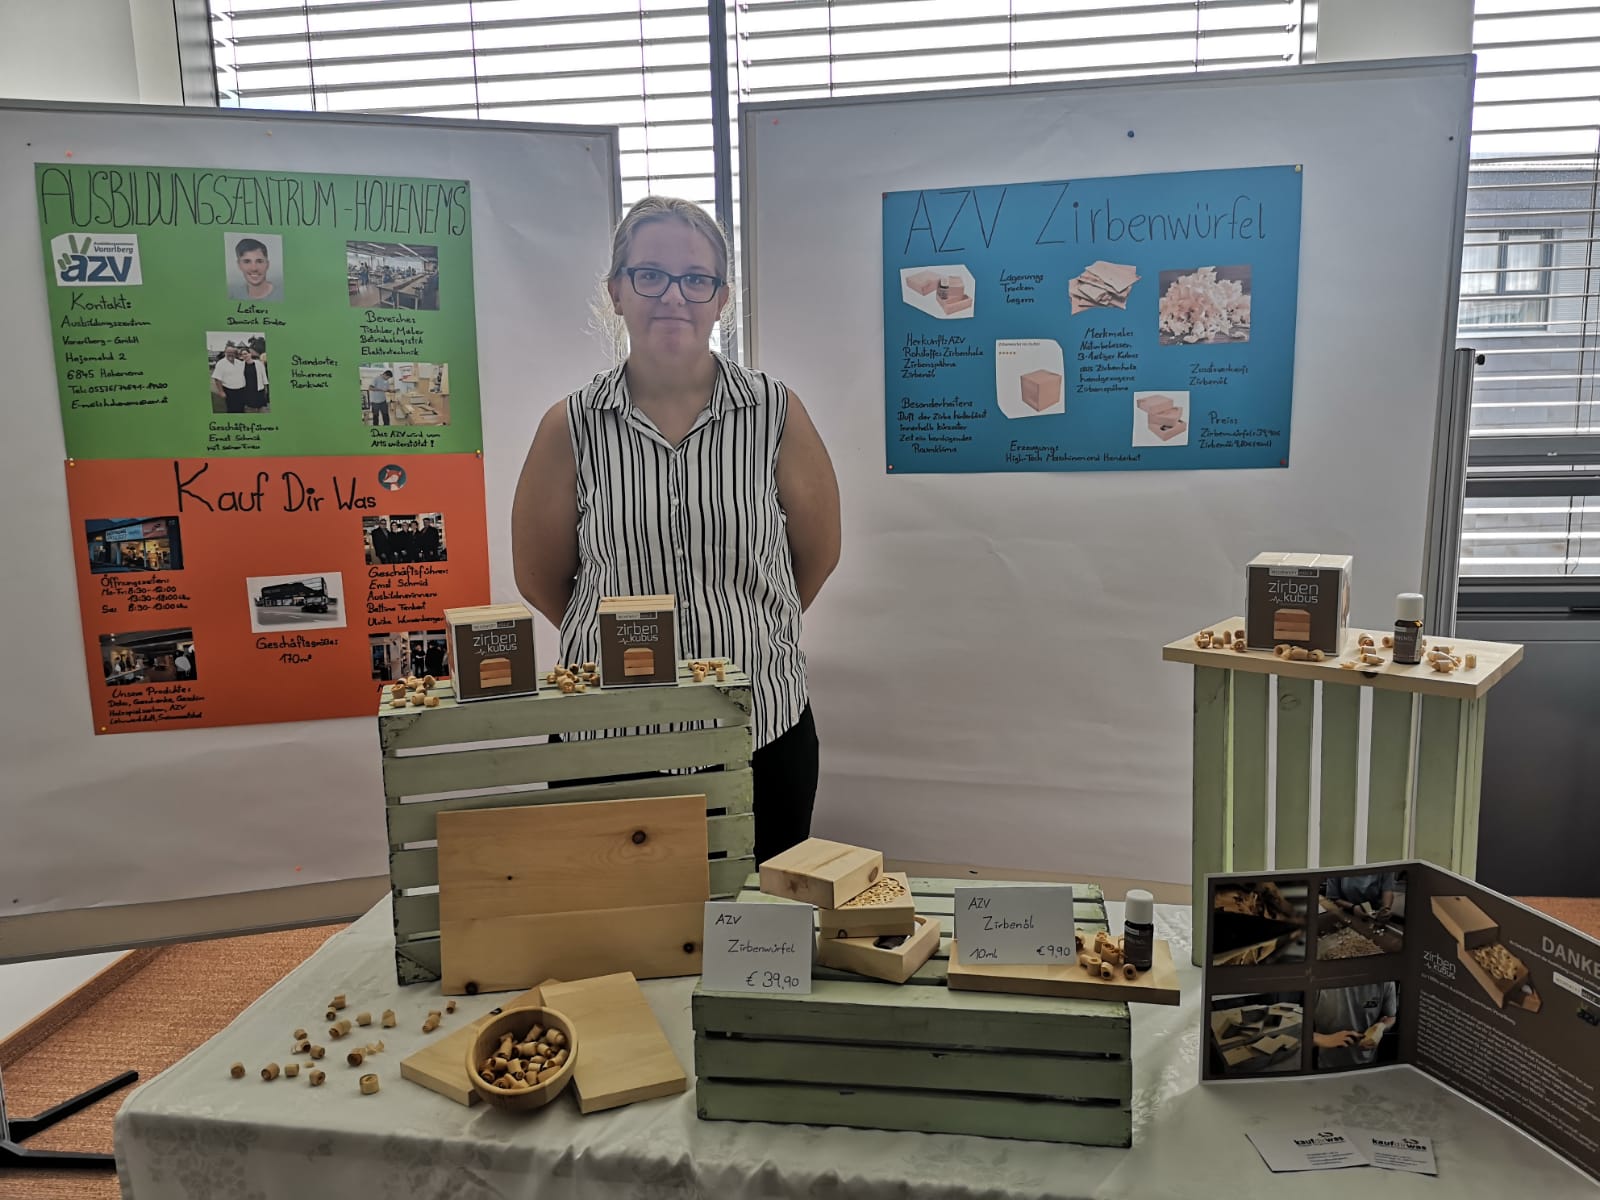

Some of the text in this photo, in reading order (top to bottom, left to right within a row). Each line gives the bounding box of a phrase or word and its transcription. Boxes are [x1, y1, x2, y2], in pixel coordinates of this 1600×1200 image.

[904, 182, 1266, 255] AZV Zirbenwürfel
[60, 254, 133, 283] azv
[70, 291, 132, 311] Kontakt:
[236, 303, 269, 315] Leiter:
[365, 310, 416, 324] Bereiche:
[118, 352, 127, 361] 2
[291, 355, 338, 367] Standorte:
[66, 369, 96, 381] 6845
[174, 461, 377, 513] Kauf Dir Was
[1268, 579, 1319, 597] zirben
[1284, 592, 1319, 604] kubus
[616, 622, 659, 637] zirben
[473, 631, 517, 648] zirben
[629, 632, 659, 643] kubus
[487, 641, 518, 653] kubus
[968, 896, 991, 910] AZV
[715, 913, 742, 925] AZV
[983, 914, 1034, 931] Zirbenöl
[728, 939, 796, 955] Zirbenwürfel
[1423, 950, 1456, 974] zirben
